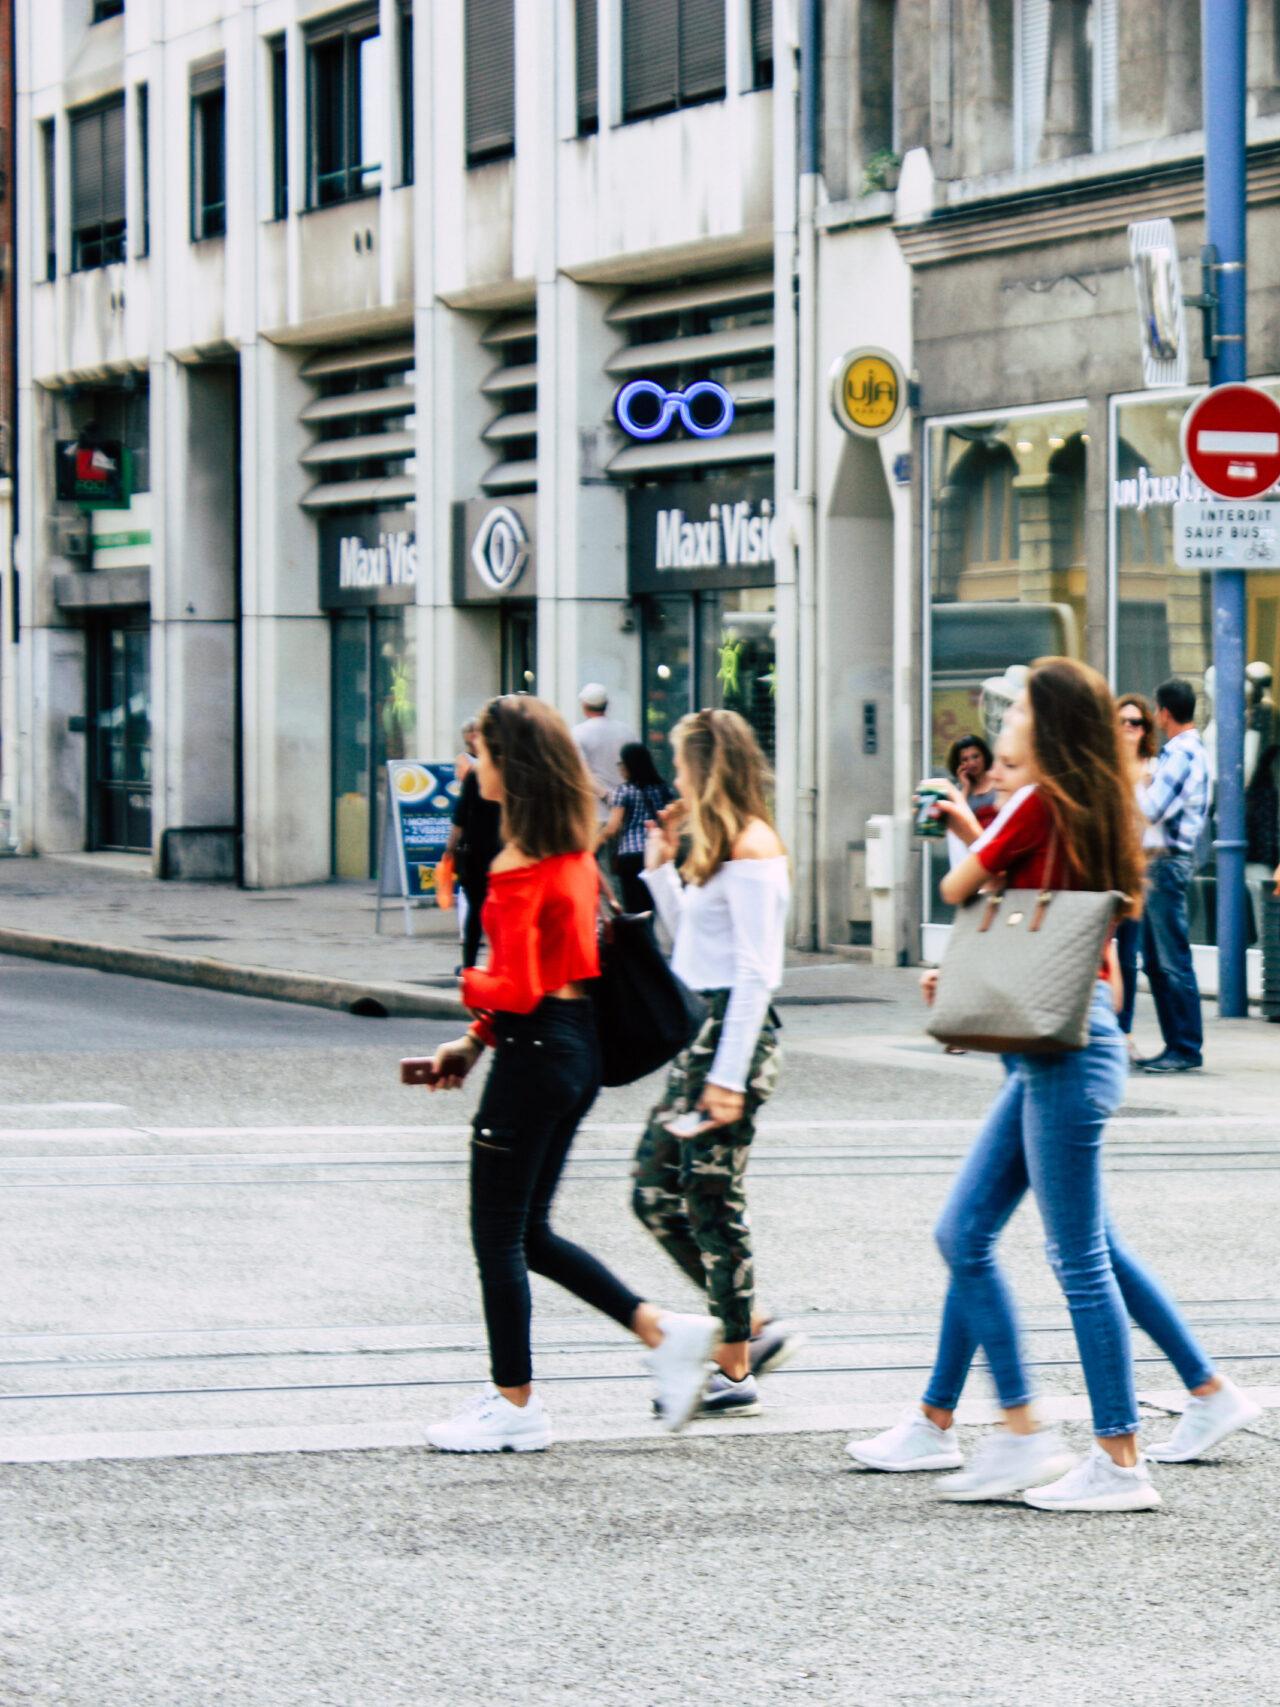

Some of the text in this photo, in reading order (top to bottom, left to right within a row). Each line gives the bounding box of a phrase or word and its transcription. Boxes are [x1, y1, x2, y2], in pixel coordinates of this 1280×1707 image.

[1201, 509, 1272, 522] INTERDIT
[656, 502, 720, 569] Maxi
[1184, 526, 1261, 539] SAUF BUS
[1184, 546, 1224, 559] SAUF
[340, 532, 387, 588] Maxi
